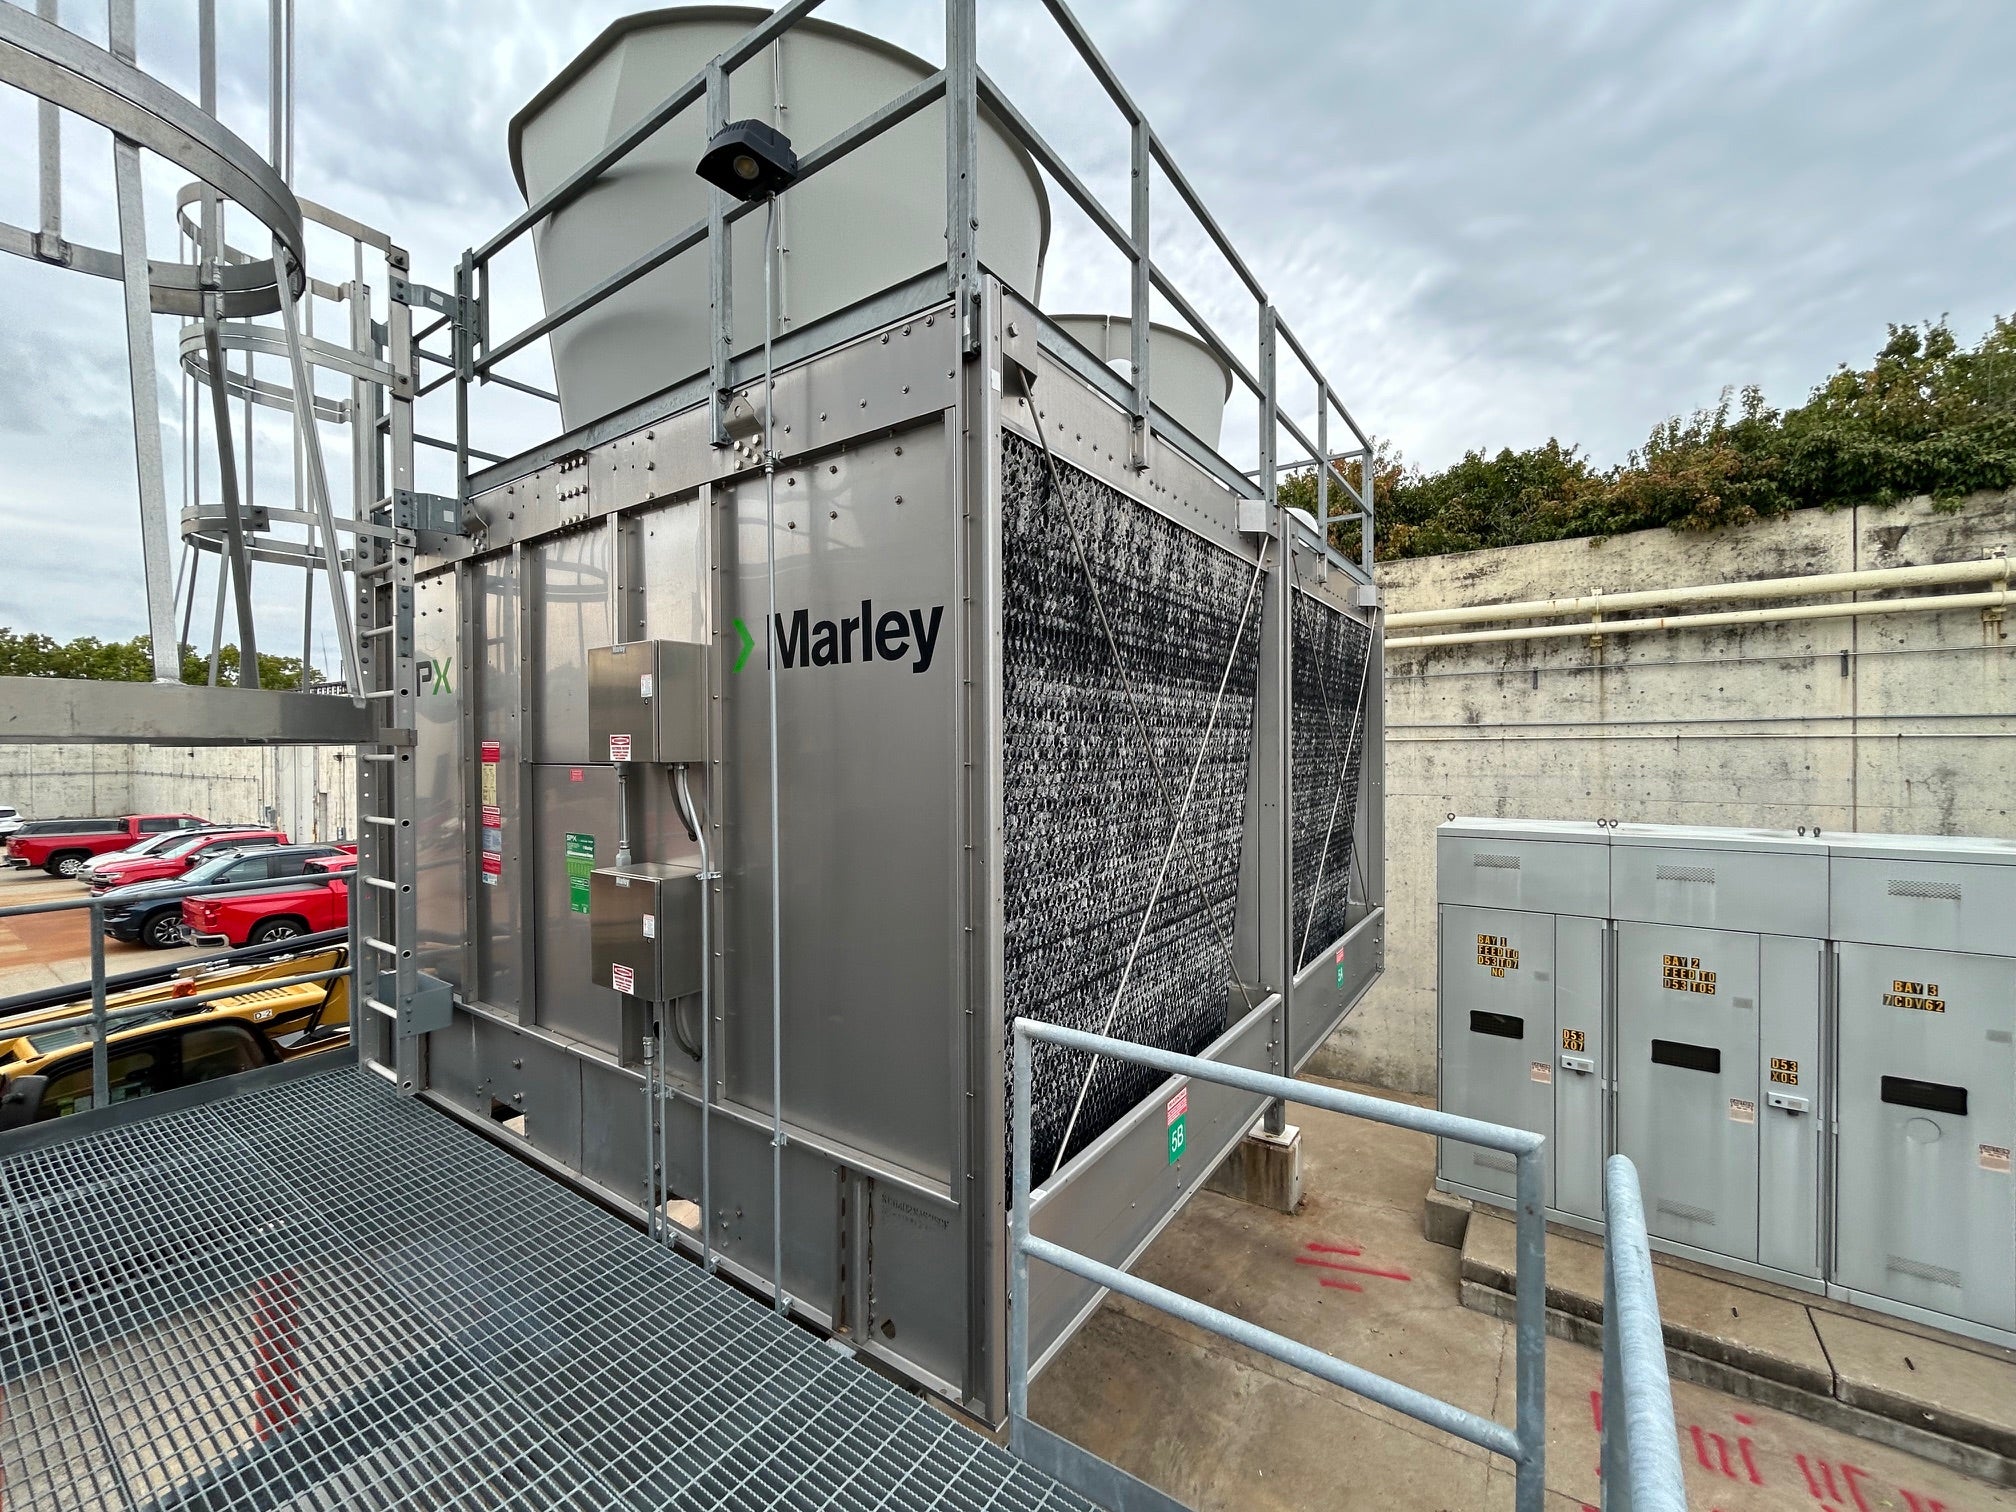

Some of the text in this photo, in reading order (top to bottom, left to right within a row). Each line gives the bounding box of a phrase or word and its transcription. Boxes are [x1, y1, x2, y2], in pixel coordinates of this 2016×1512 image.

[767, 599, 944, 673] Marley
[416, 657, 452, 697] PX
[1478, 934, 1497, 945] BAY
[1478, 945, 1503, 957] FEED
[1478, 955, 1497, 966] D53
[1664, 956, 1699, 969] BAY 2
[1664, 967, 1715, 982] FEED TO
[1664, 979, 1687, 991] D53
[1894, 981, 1937, 996] BAY 3
[1884, 994, 1944, 1012] 7CDV62
[1564, 1030, 1584, 1041] D53
[1772, 1058, 1797, 1072] D53
[1171, 1124, 1184, 1153] 5B
